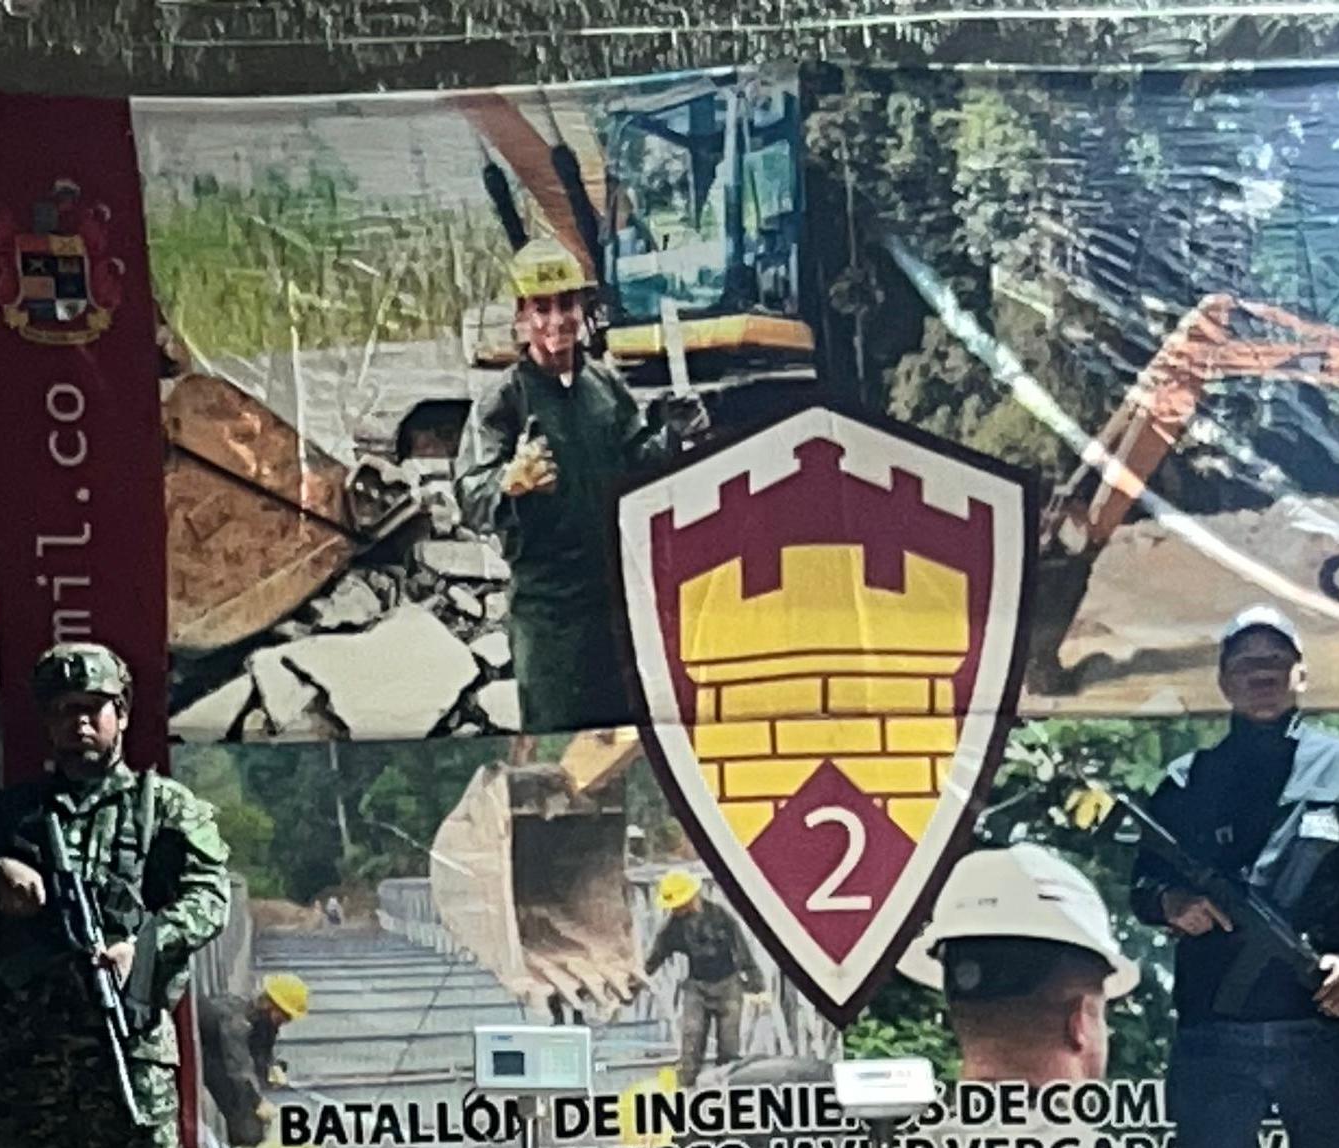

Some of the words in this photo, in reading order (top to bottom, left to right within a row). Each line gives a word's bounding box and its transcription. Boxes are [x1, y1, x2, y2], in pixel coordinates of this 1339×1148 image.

[804, 805, 873, 911] 2
[556, 1095, 619, 1140] DE
[636, 1085, 946, 1135] INGENIES
[960, 1083, 1028, 1125] DE
